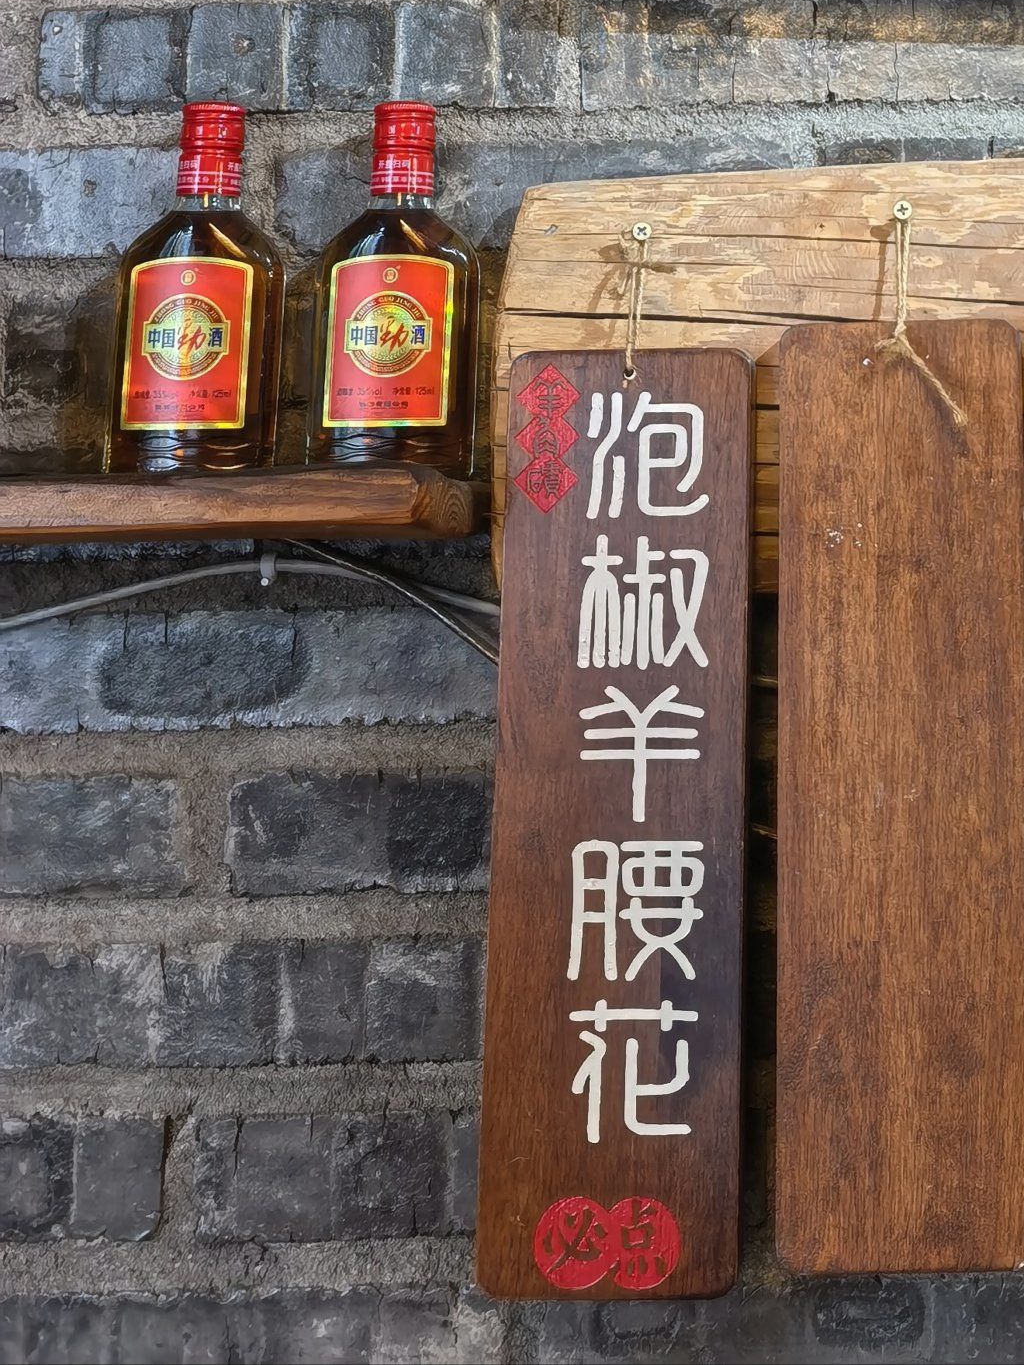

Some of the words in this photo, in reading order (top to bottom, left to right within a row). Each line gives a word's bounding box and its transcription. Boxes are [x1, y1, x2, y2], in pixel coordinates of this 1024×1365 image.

[148, 319, 224, 358] 中国劲酒
[351, 316, 426, 354] 中国劲酒
[567, 391, 709, 1144] 泡椒羊腰花
[543, 1197, 666, 1278] 必点
